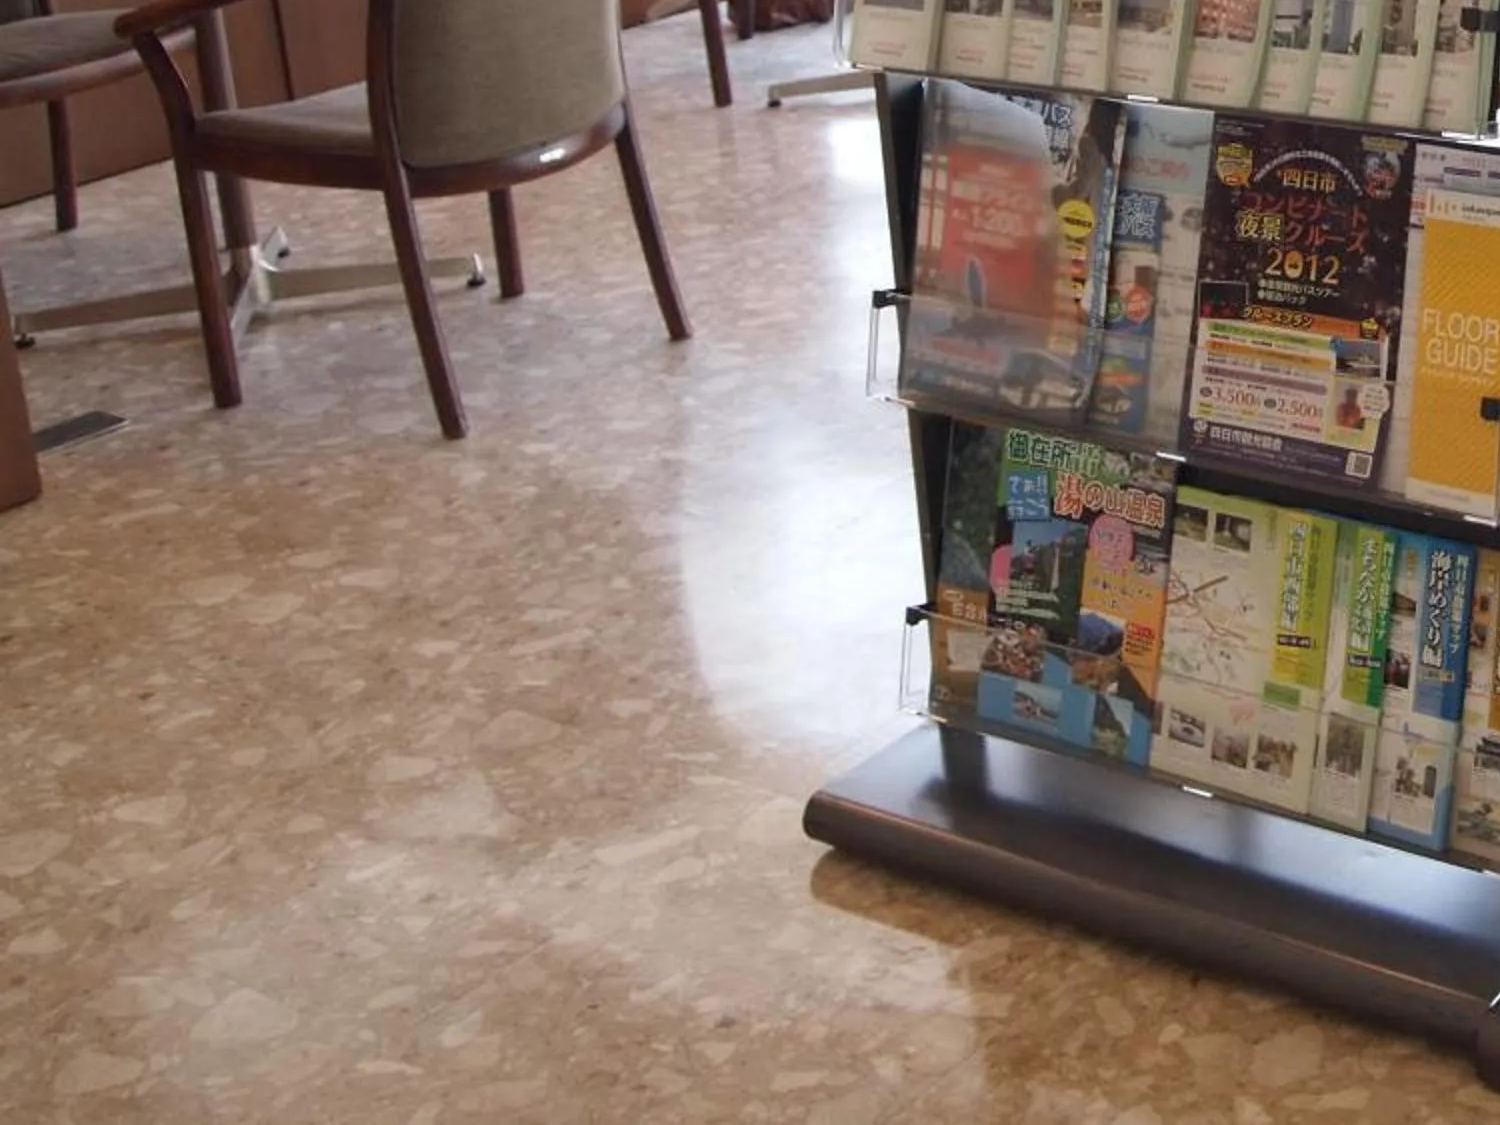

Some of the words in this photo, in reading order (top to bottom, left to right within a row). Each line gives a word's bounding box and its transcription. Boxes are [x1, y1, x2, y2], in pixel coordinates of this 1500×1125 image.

[1281, 167, 1338, 194] 四日市
[1238, 211, 1284, 242] 夜景
[1264, 247, 1342, 286] 2012
[1422, 307, 1500, 347] FLOOR
[1425, 336, 1500, 375] GUIDE
